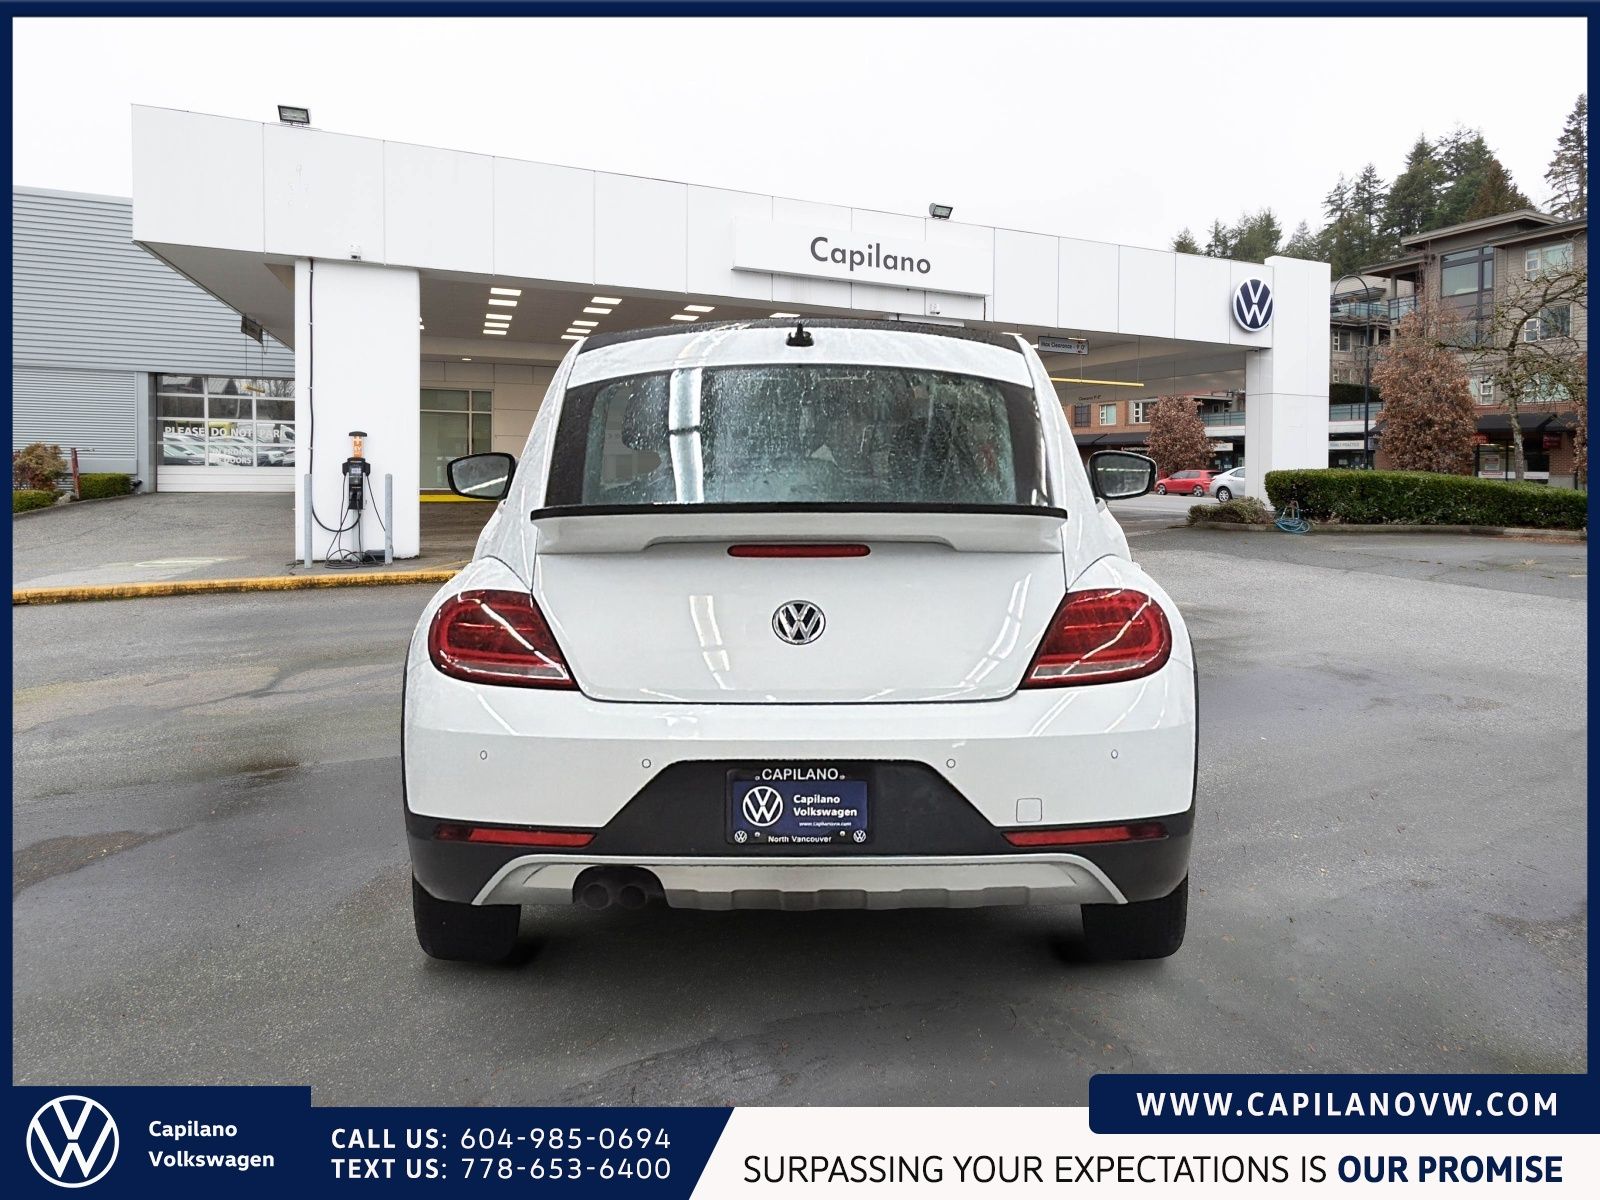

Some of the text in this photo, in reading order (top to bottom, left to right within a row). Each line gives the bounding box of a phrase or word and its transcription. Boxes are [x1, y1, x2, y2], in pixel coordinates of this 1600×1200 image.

[810, 236, 931, 275] Capilano
[1233, 277, 1274, 331] VW
[164, 426, 205, 438] PLEASE
[211, 428, 226, 437] DO
[230, 428, 253, 438] NOT
[772, 600, 826, 645] VW
[762, 768, 839, 781] CAPILANO
[793, 794, 841, 806] Capilano
[793, 807, 858, 818] Volkswagen
[768, 835, 832, 843] North Vancouver
